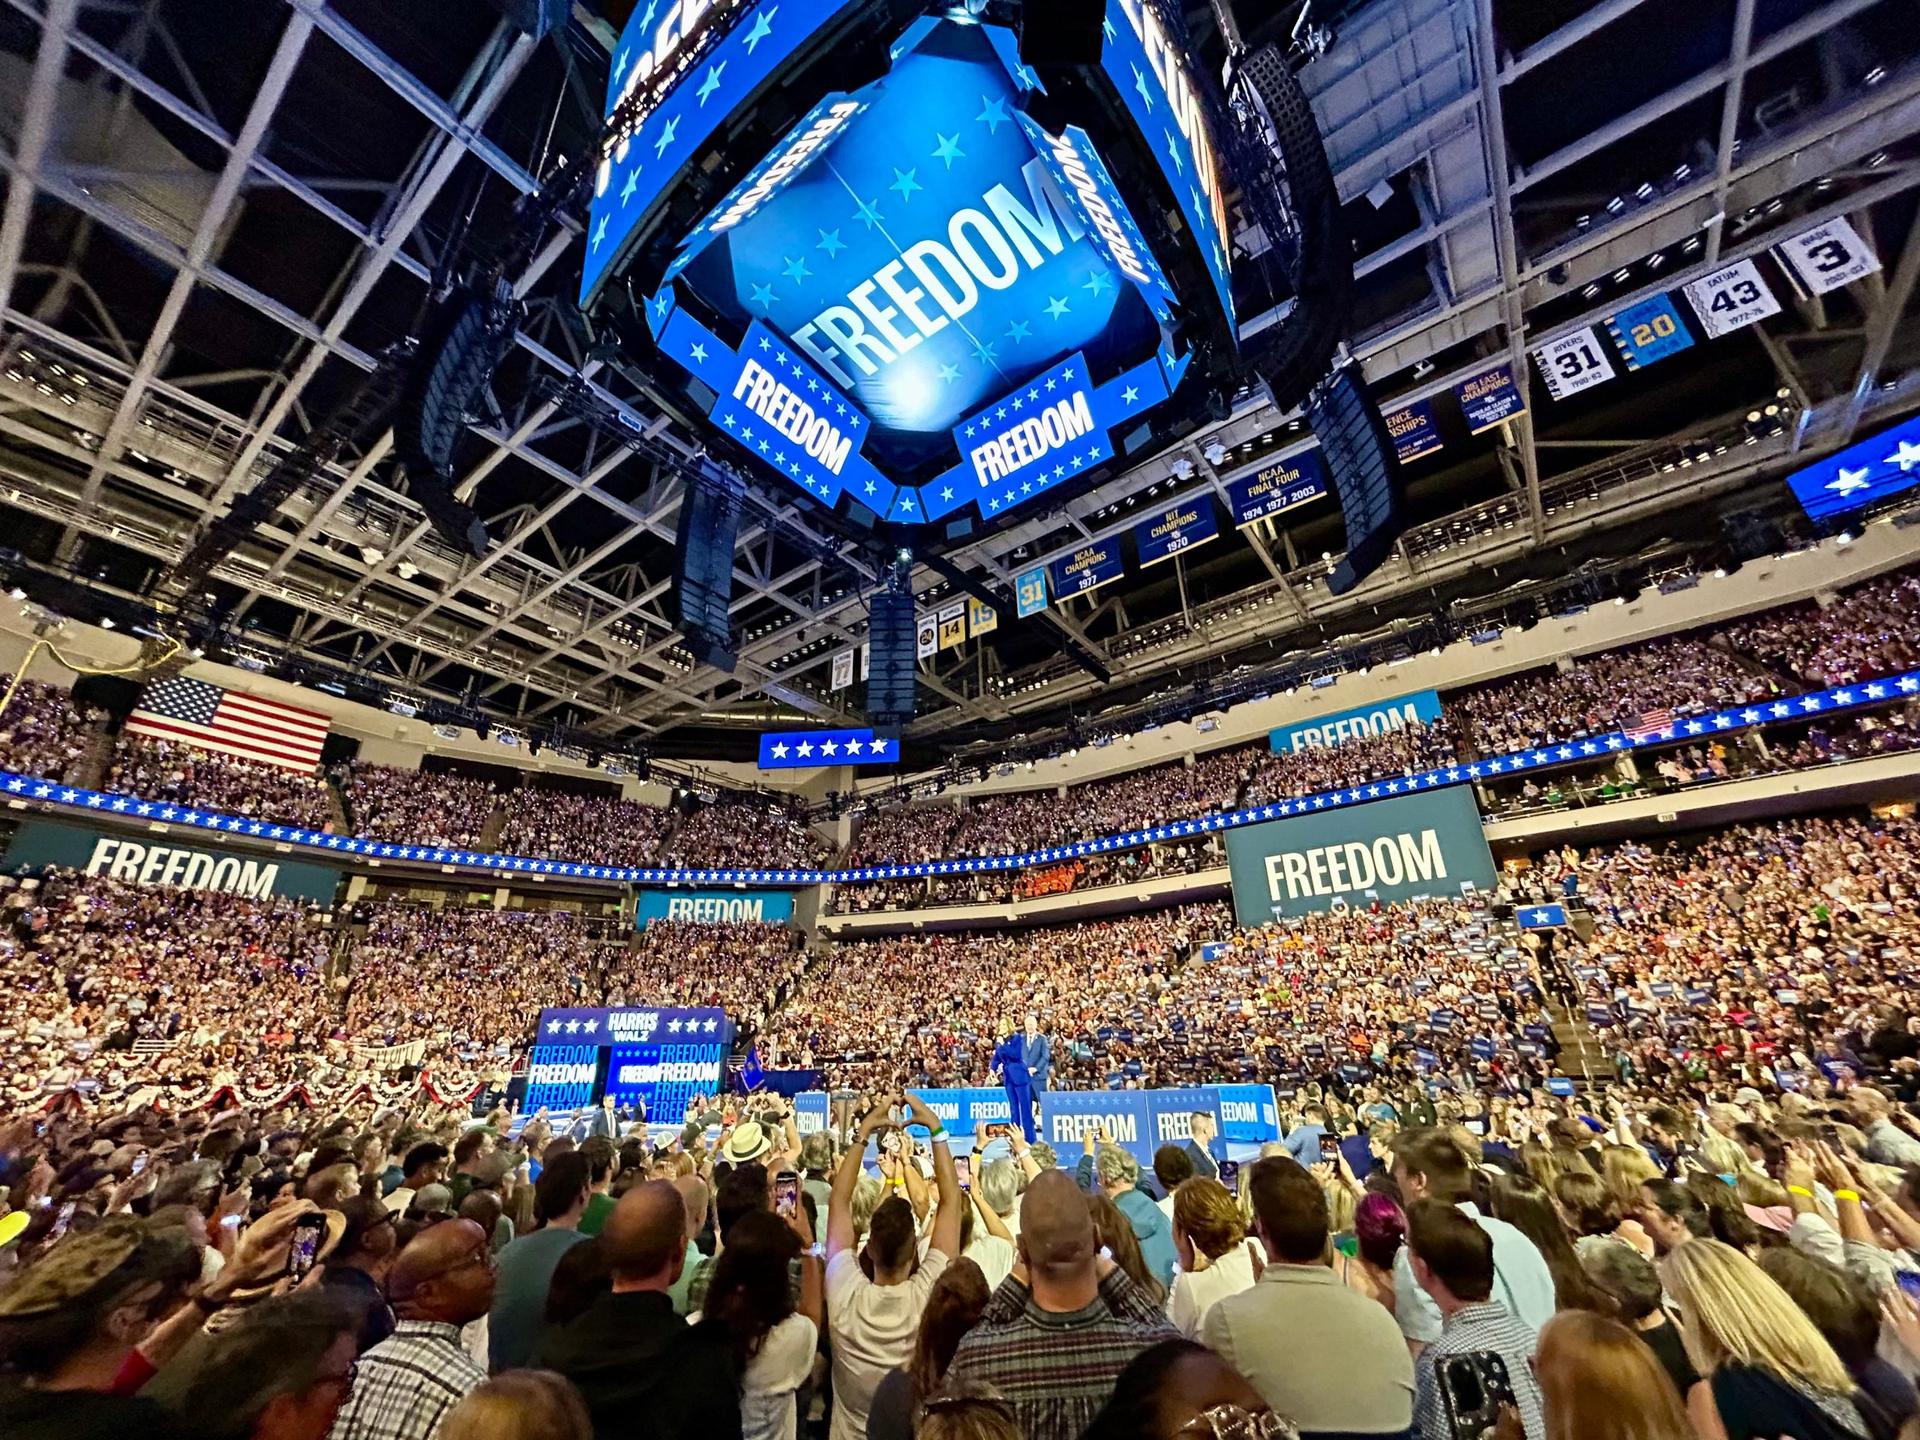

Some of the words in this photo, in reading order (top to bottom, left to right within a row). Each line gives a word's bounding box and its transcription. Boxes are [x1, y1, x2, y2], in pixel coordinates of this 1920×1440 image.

[708, 101, 859, 232] FREEDOM
[1042, 133, 1150, 284] FREEDOM
[1806, 240, 1852, 272] 3
[790, 155, 1086, 391] FREEDOM
[1707, 269, 1741, 288] TATUM
[1711, 280, 1761, 312] 43
[1631, 313, 1676, 348] 20
[1553, 336, 1585, 354] RIVERS
[1555, 344, 1601, 379] 31
[1460, 376, 1511, 403] CHAMPIONS
[732, 358, 853, 477] FREEDOM
[970, 390, 1095, 488] FREEDOM
[1247, 480, 1275, 498] FINAL
[1274, 468, 1301, 486] FOUR
[1257, 464, 1285, 484] NCAA
[1165, 508, 1180, 523] NIT
[1242, 505, 1263, 521] 1974
[1265, 495, 1288, 512] 1977
[1290, 485, 1316, 503] 2003
[1150, 510, 1198, 538] CHAMPIONS
[1074, 547, 1096, 563] NCAA
[1166, 536, 1189, 553] 1970
[1064, 550, 1107, 576] CHAMPIONS
[1020, 580, 1044, 607] 31
[1078, 574, 1098, 590] 1977
[944, 619, 961, 639] 14
[1289, 703, 1420, 755] FREEDOM
[85, 838, 280, 902] FREEDOM
[1264, 828, 1448, 902] FREEDOM
[667, 898, 764, 924] FREEDOM
[608, 1012, 658, 1031] HARRIS
[614, 1030, 649, 1042] WALZ
[533, 1045, 599, 1064] FREEDOM
[659, 1043, 721, 1063] FREEDOM
[527, 1063, 597, 1085] FREEDOM
[656, 1061, 720, 1082] FREEDOM
[524, 1083, 593, 1105] FREEDOM
[970, 1101, 1011, 1119] FREEDO
